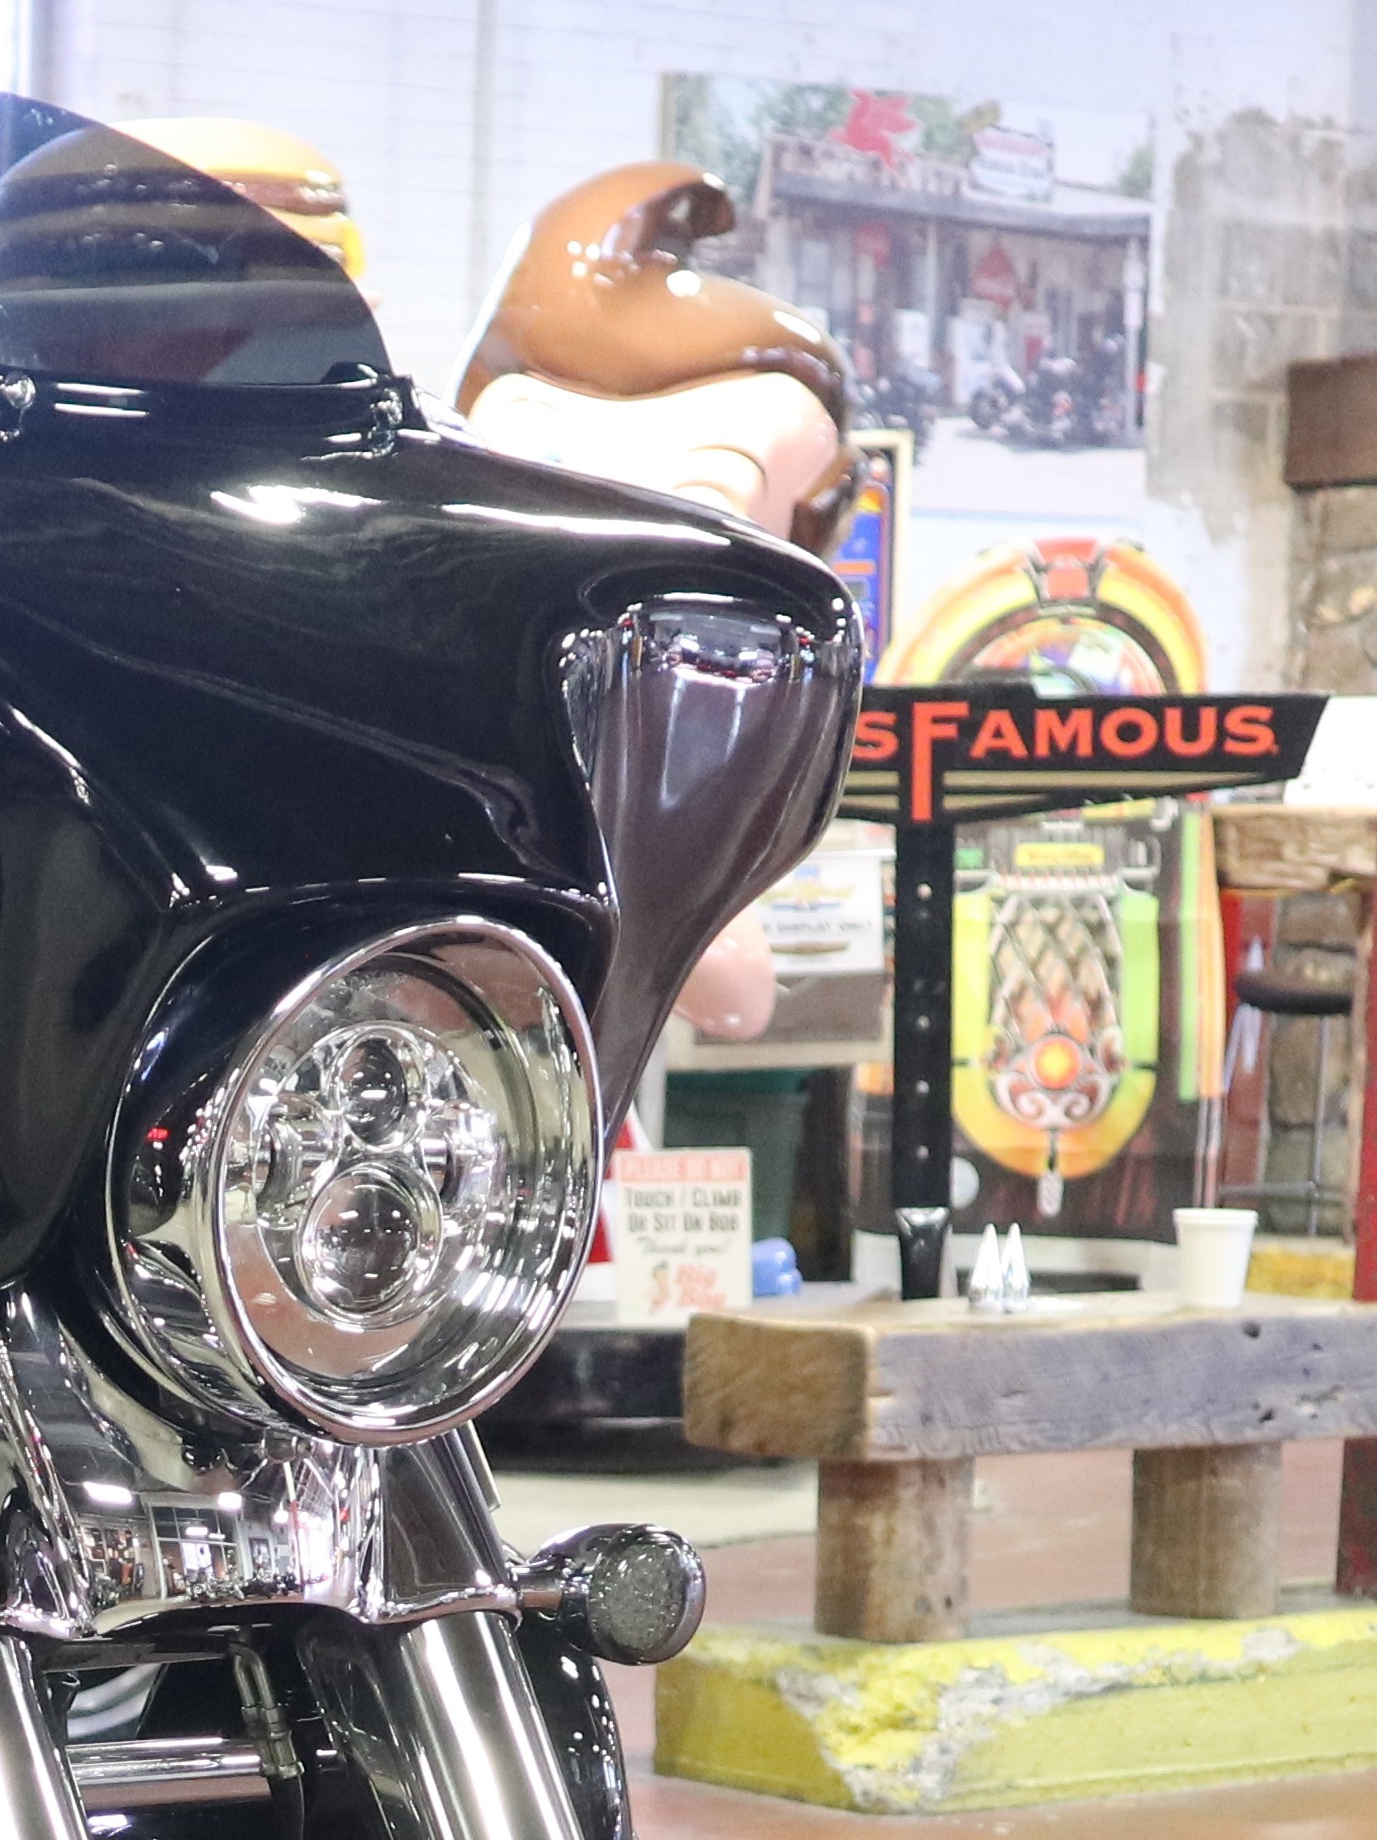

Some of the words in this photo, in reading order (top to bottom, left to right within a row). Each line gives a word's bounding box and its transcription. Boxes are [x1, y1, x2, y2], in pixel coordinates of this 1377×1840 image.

[912, 701, 1276, 823] FAMOUS
[624, 1187, 675, 1207] TOUCH
[693, 1187, 742, 1207] CLIMB
